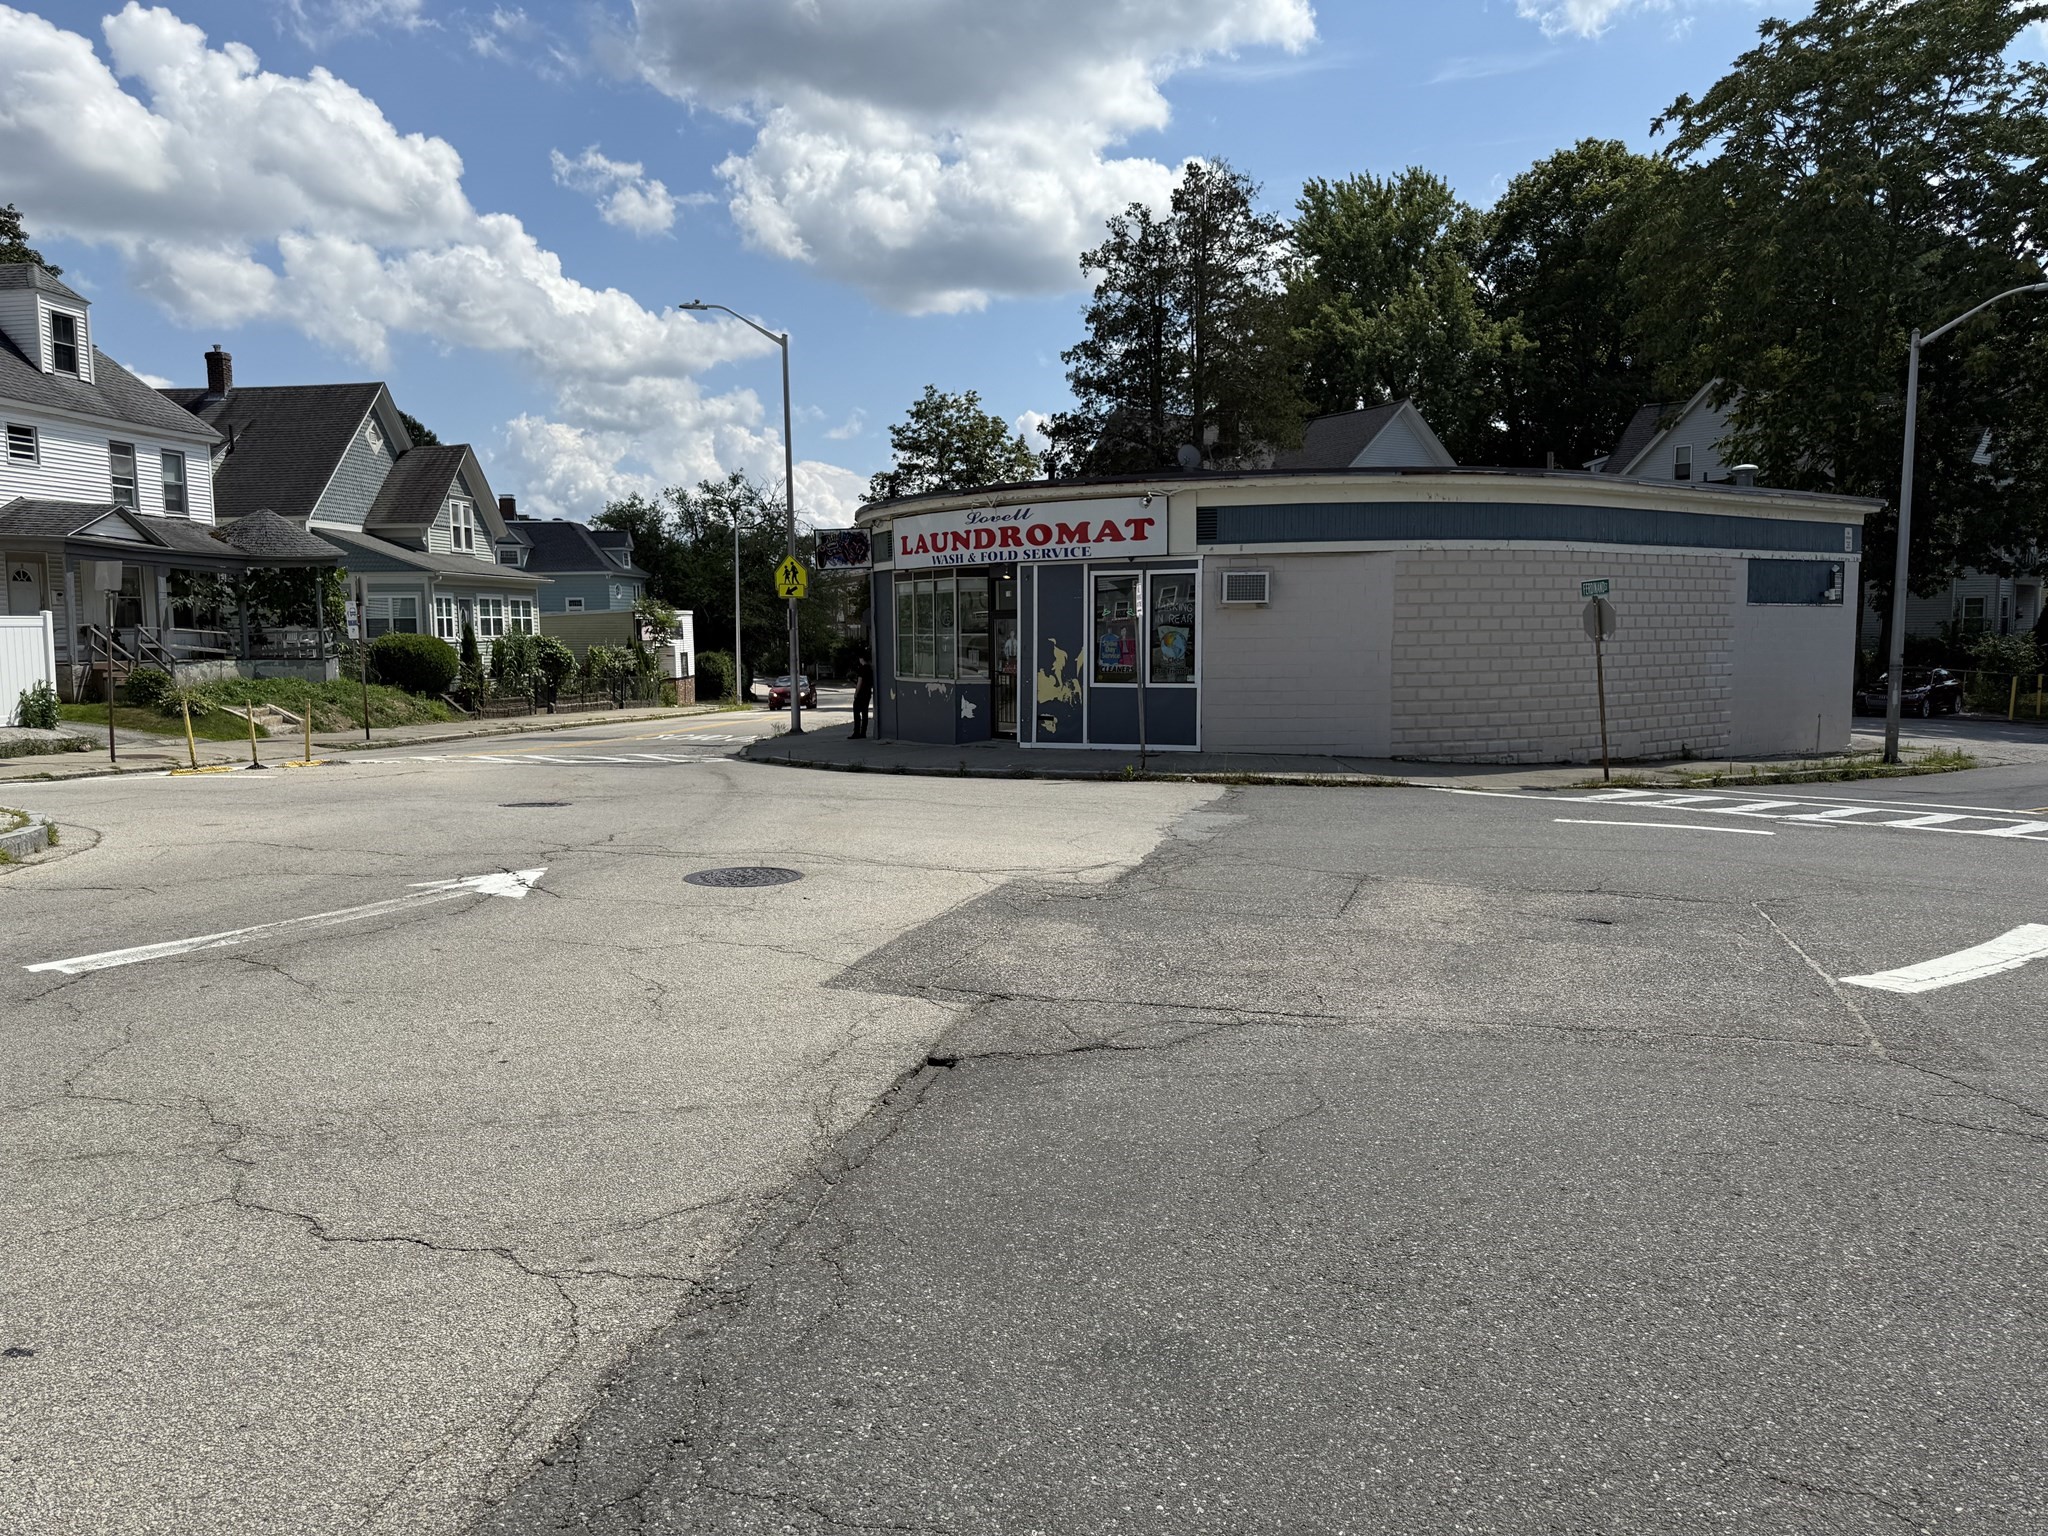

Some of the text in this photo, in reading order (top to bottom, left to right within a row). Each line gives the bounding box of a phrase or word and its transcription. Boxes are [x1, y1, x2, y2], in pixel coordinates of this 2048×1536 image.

[965, 508, 1034, 525] Lovell
[901, 518, 1155, 555] LAUNDROMAT
[932, 547, 1092, 565] WASH & FOLD SERVICE
[1582, 581, 1604, 595] FERDINAND
[1168, 613, 1193, 624] REAR
[1100, 665, 1134, 673] CLEANERS
